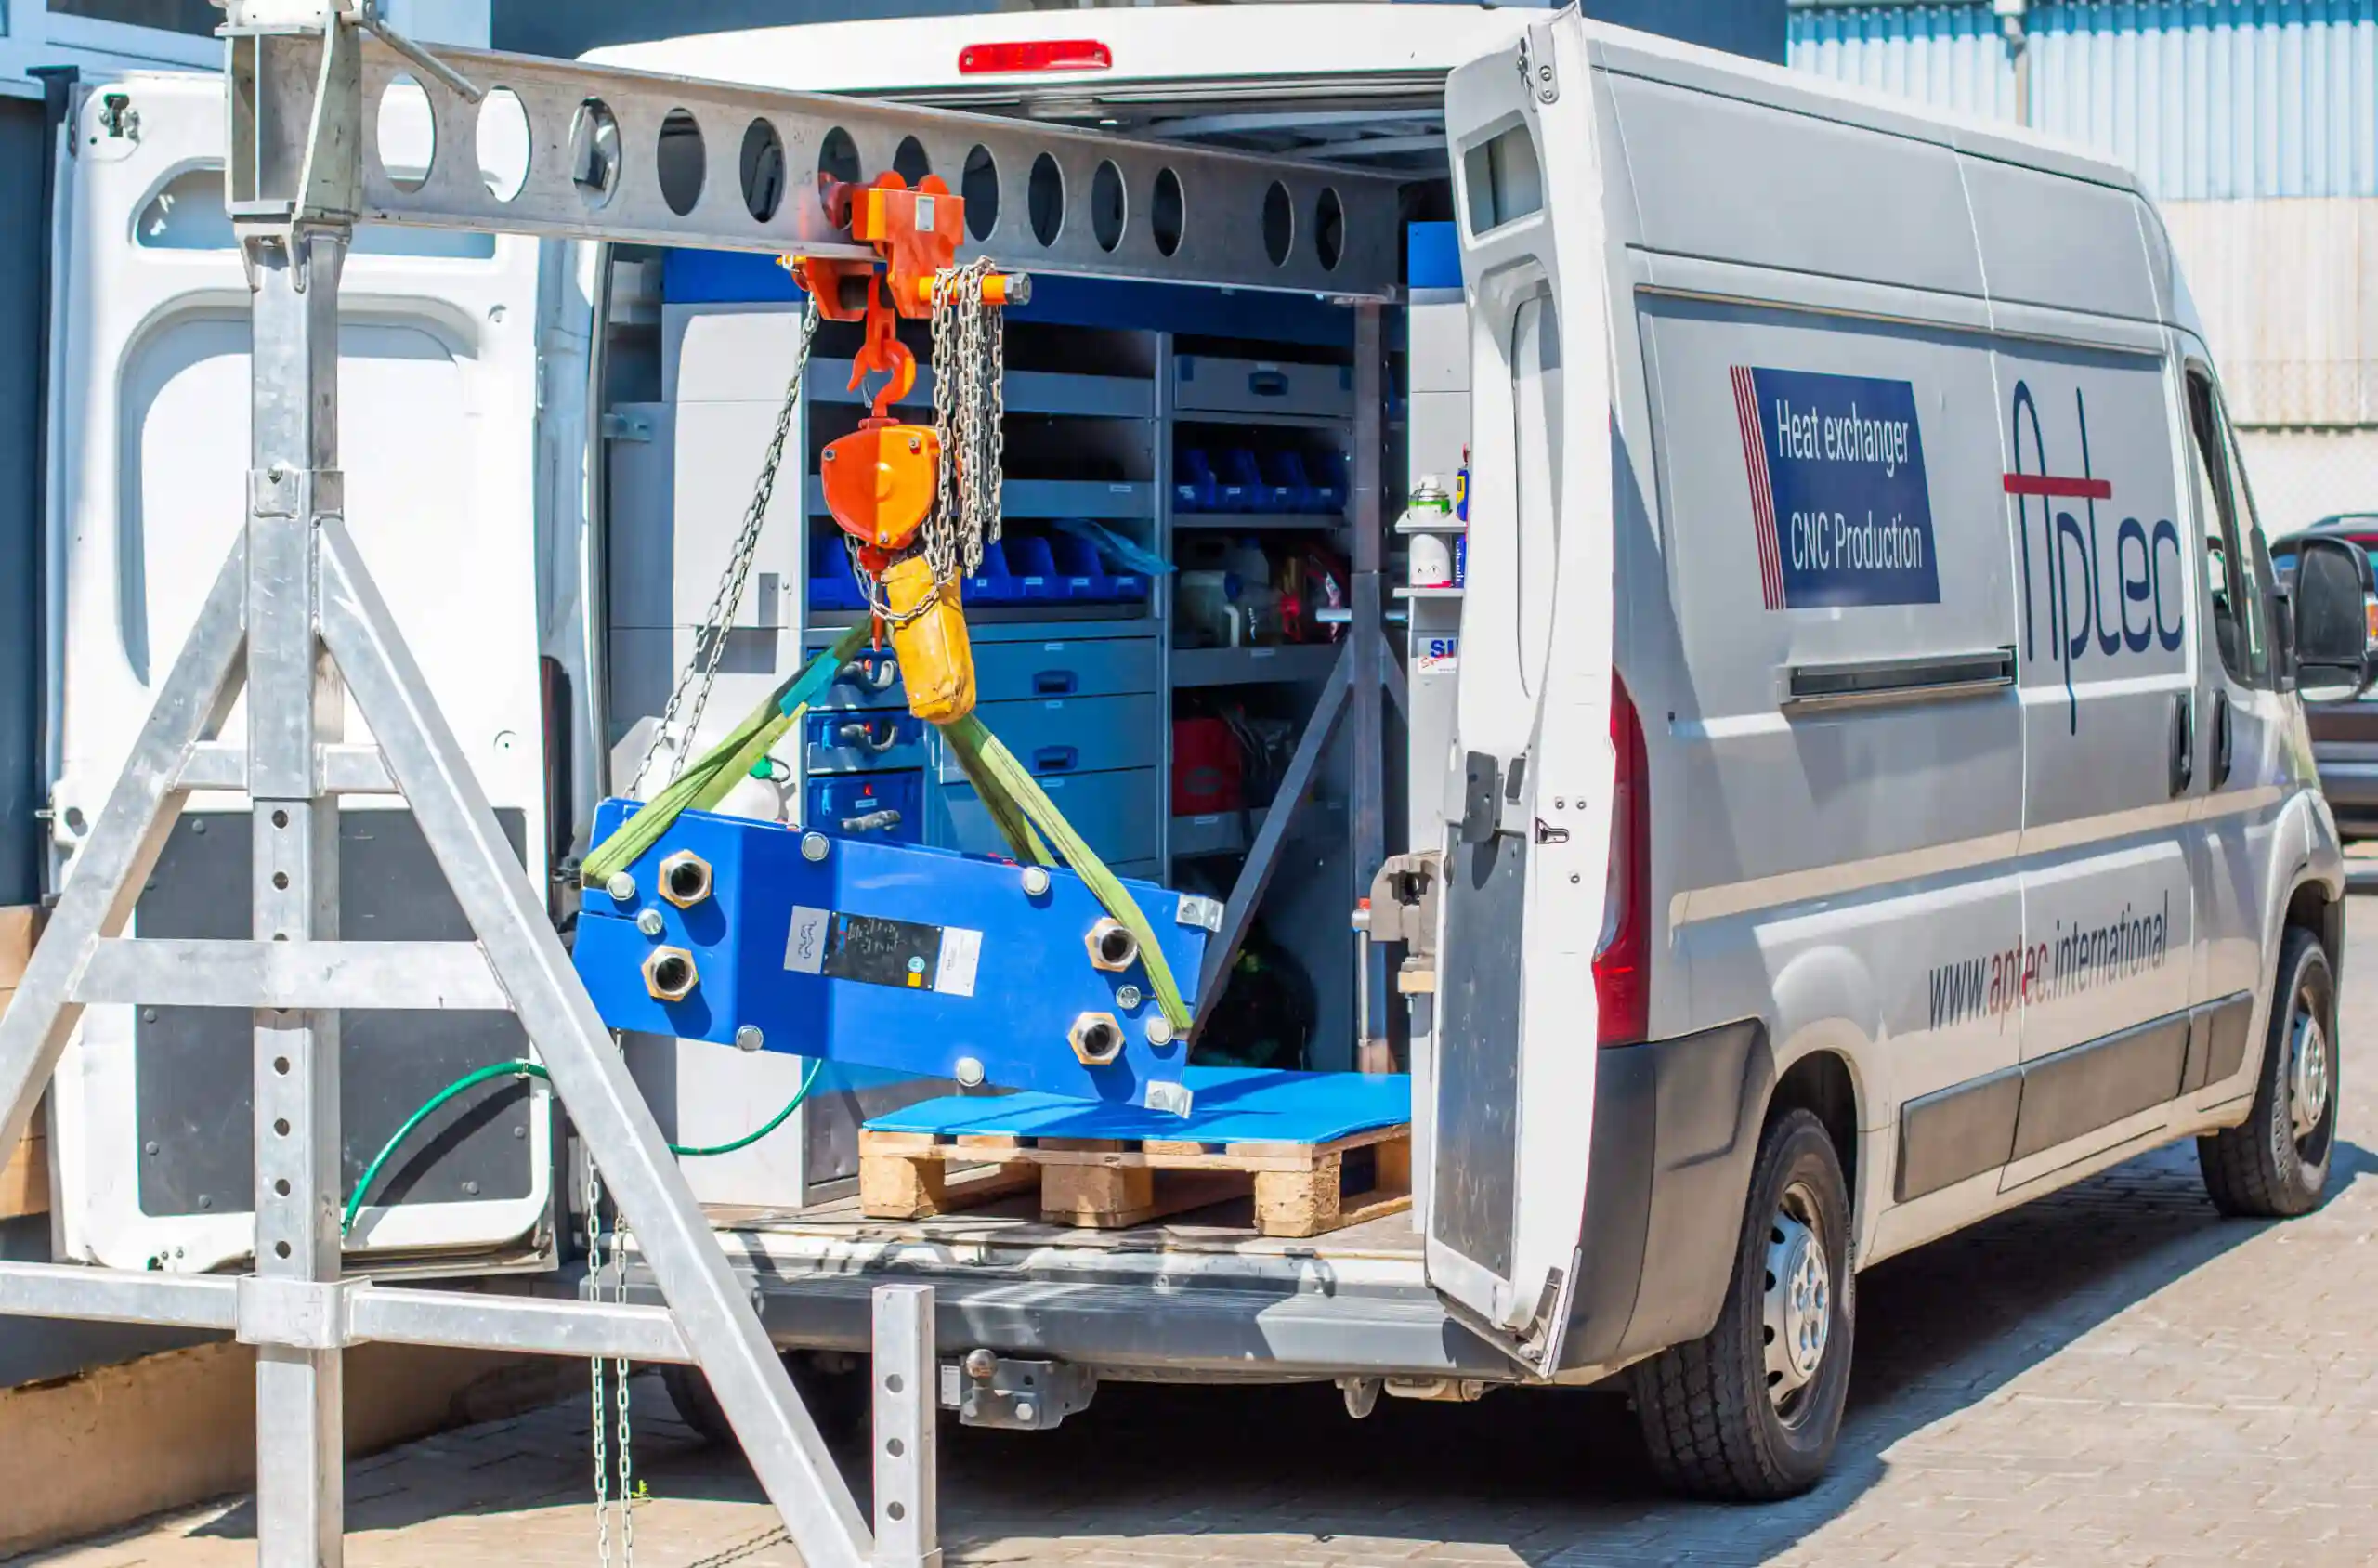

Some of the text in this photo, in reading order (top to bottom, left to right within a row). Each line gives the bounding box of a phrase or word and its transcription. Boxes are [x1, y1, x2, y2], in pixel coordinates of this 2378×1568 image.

[1776, 399, 1909, 477] Heat exchanger
[1790, 511, 1922, 571] CNC Production
[1929, 889, 2168, 1036] www.aptec.international
